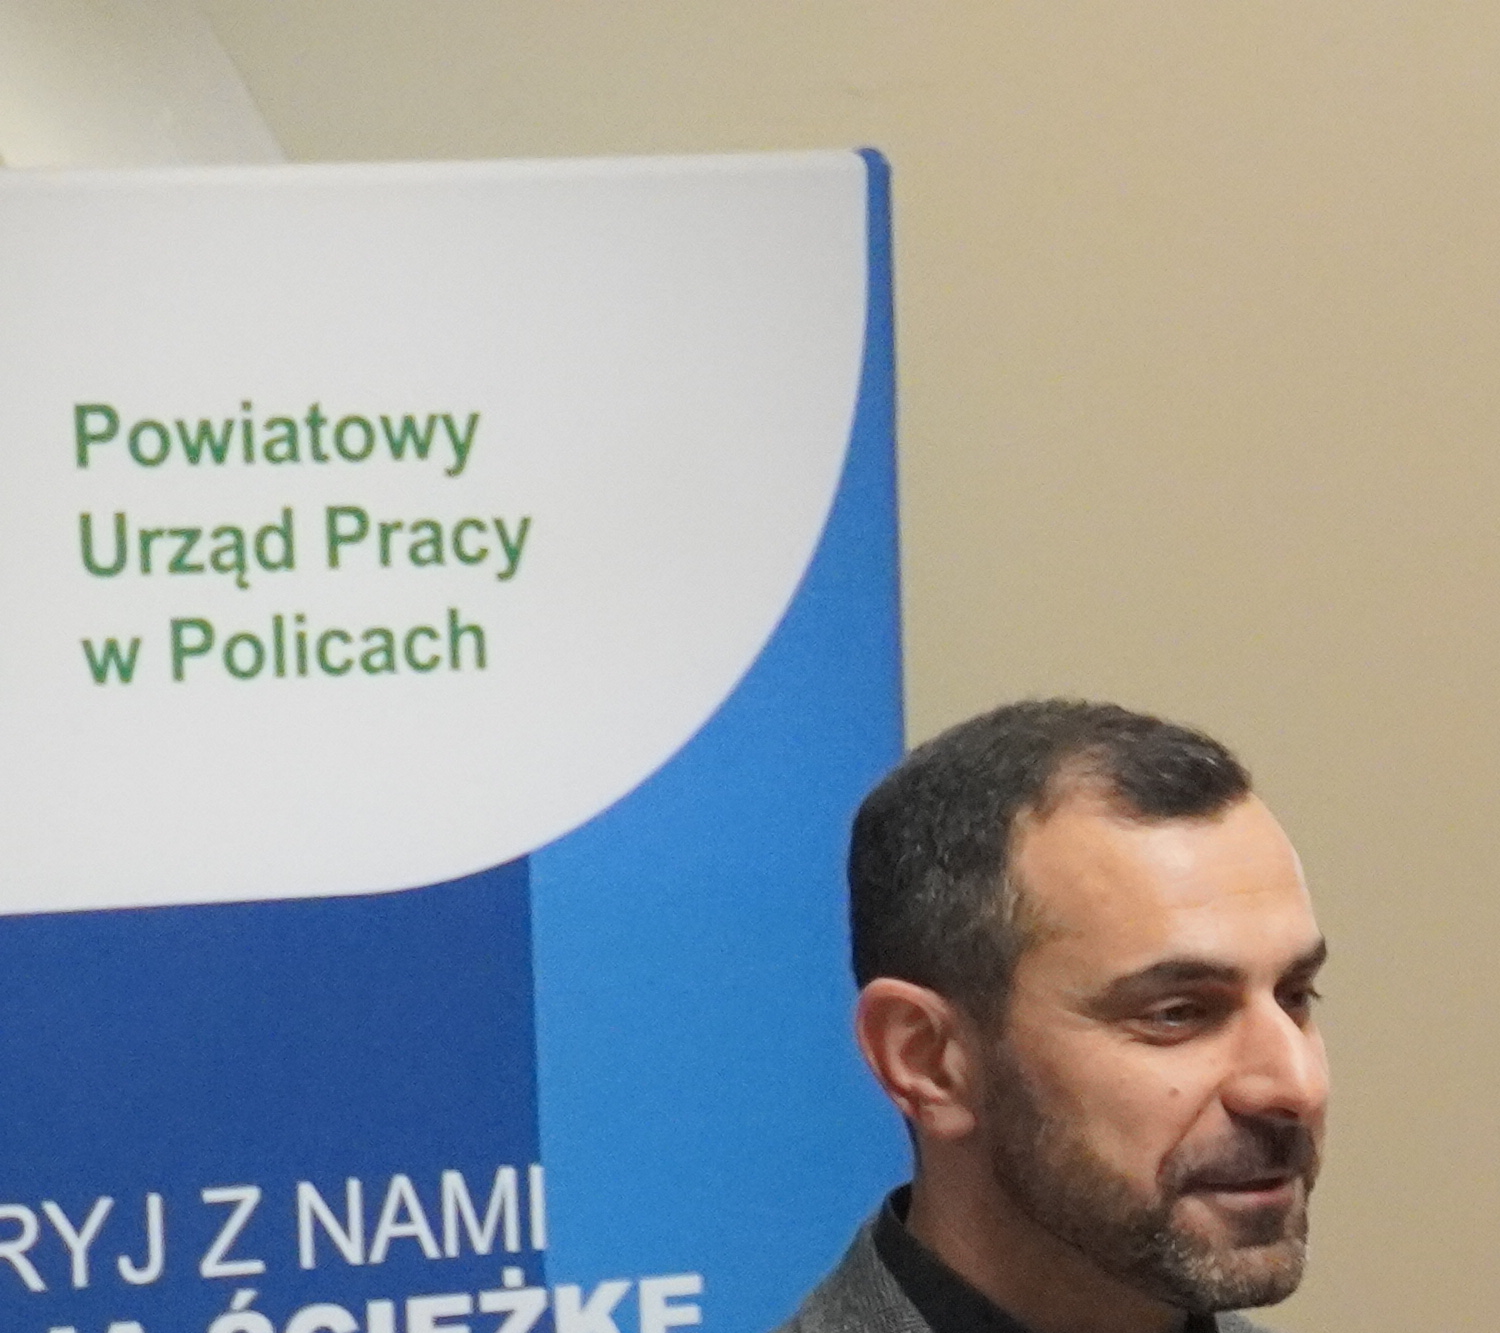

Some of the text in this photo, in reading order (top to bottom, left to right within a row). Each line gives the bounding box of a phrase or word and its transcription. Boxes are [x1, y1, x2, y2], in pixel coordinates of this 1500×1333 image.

[73, 400, 481, 477] Powiatowy
[79, 505, 532, 590] Urząd Pracy
[81, 608, 488, 685] w Policach
[0, 1164, 548, 1292] RYJ Z NAMI
